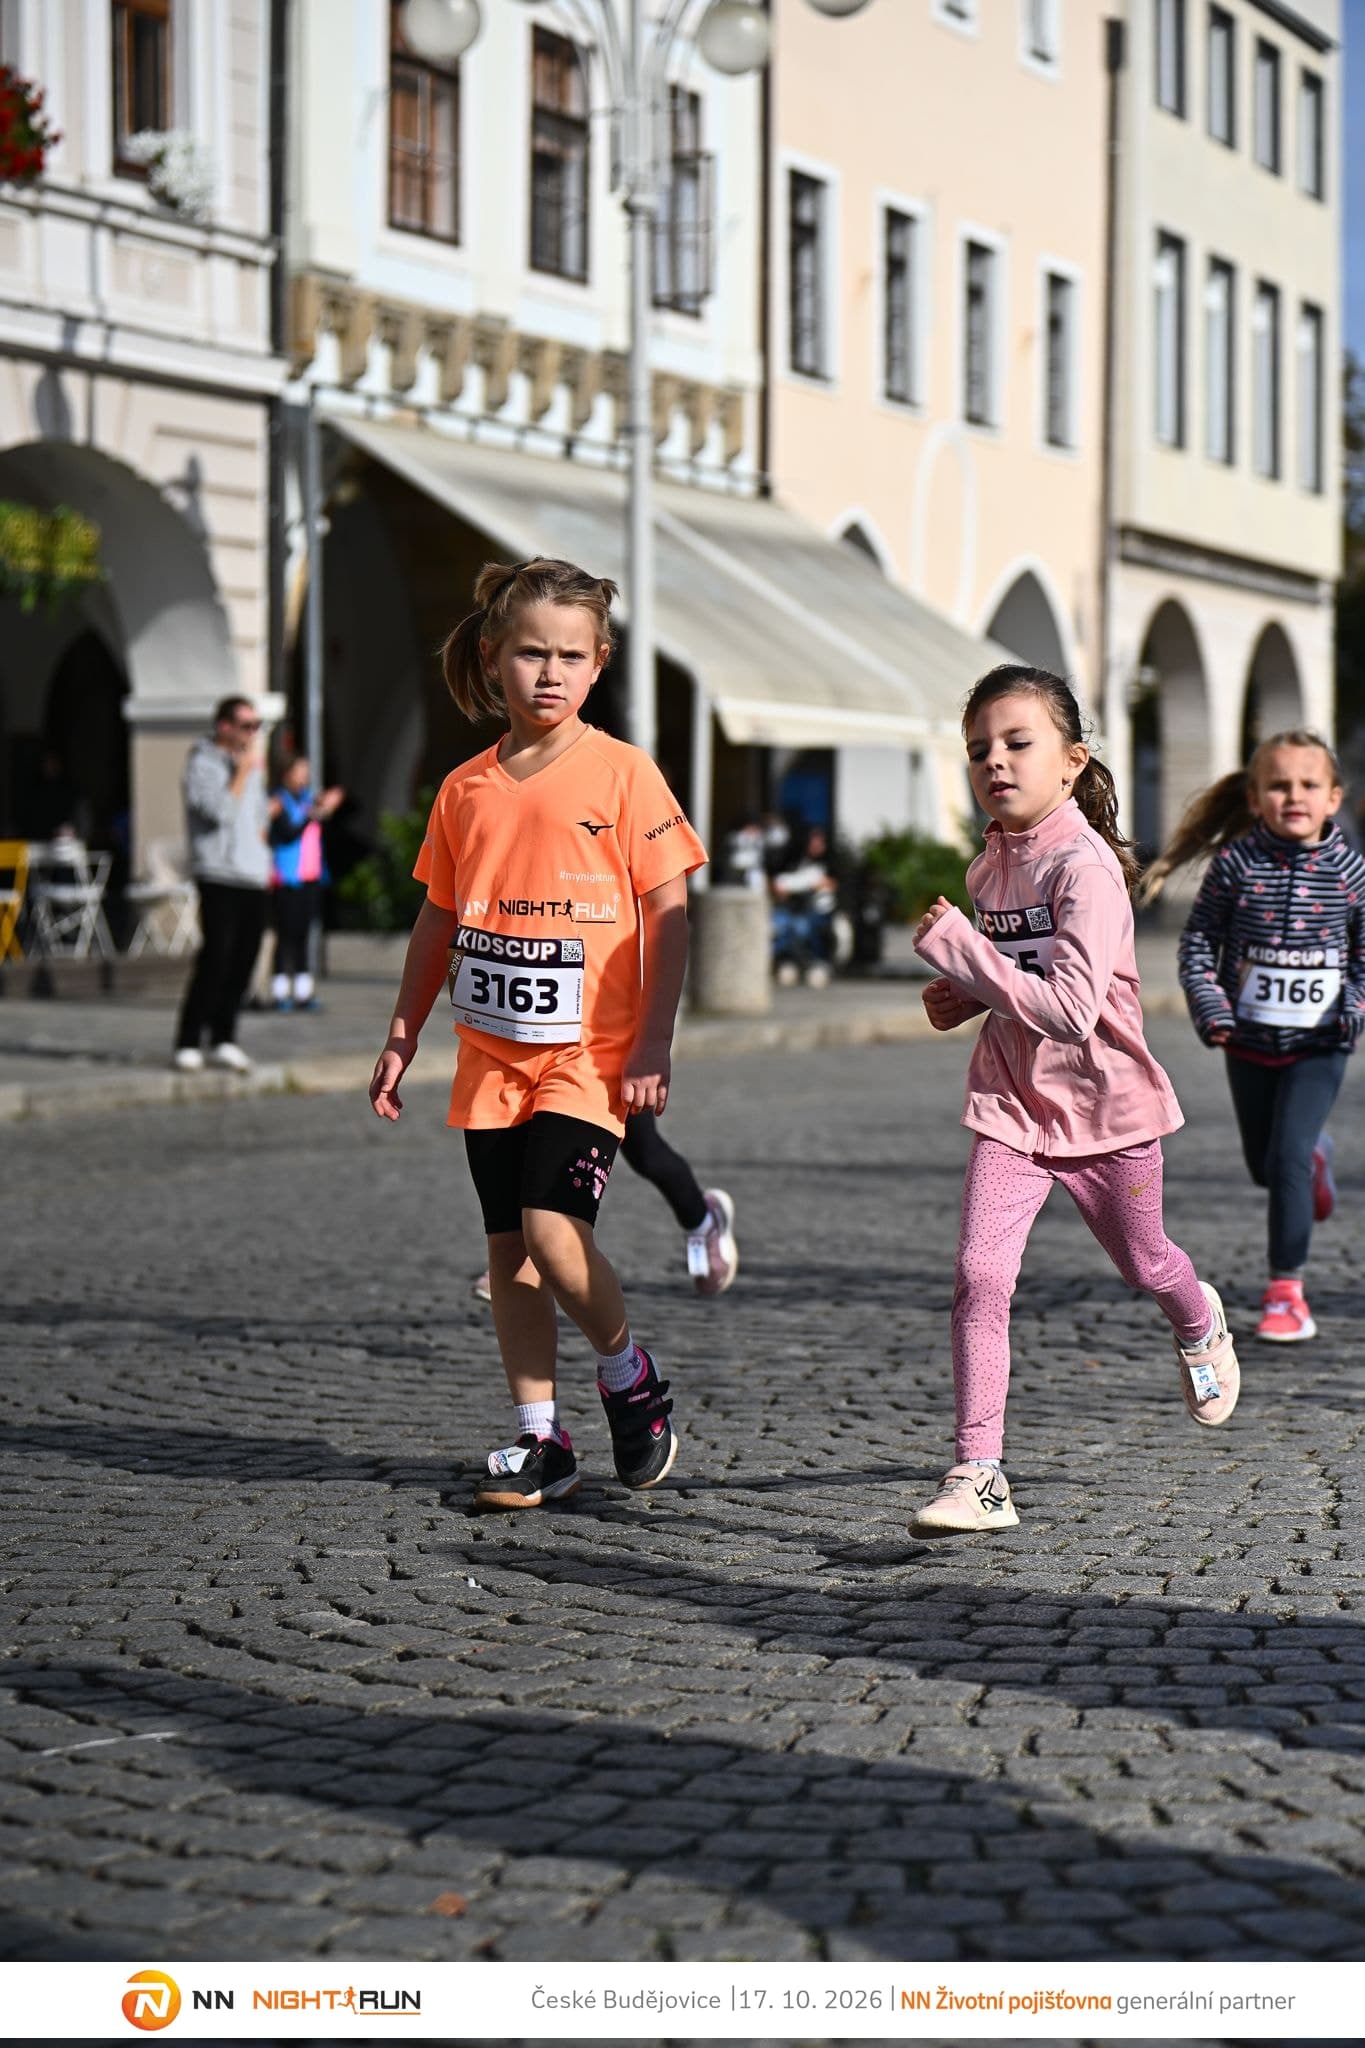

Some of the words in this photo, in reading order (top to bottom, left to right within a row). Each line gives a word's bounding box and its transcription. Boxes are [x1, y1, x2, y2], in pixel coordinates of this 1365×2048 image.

[499, 900, 561, 917] NIGHT
[575, 902, 617, 919] RUN
[456, 929, 557, 962] KIDSCUP
[1247, 946, 1325, 967] KIDSCUP
[999, 950, 1046, 981] 5
[470, 967, 559, 1015] 3163
[1255, 974, 1324, 1004] 3166
